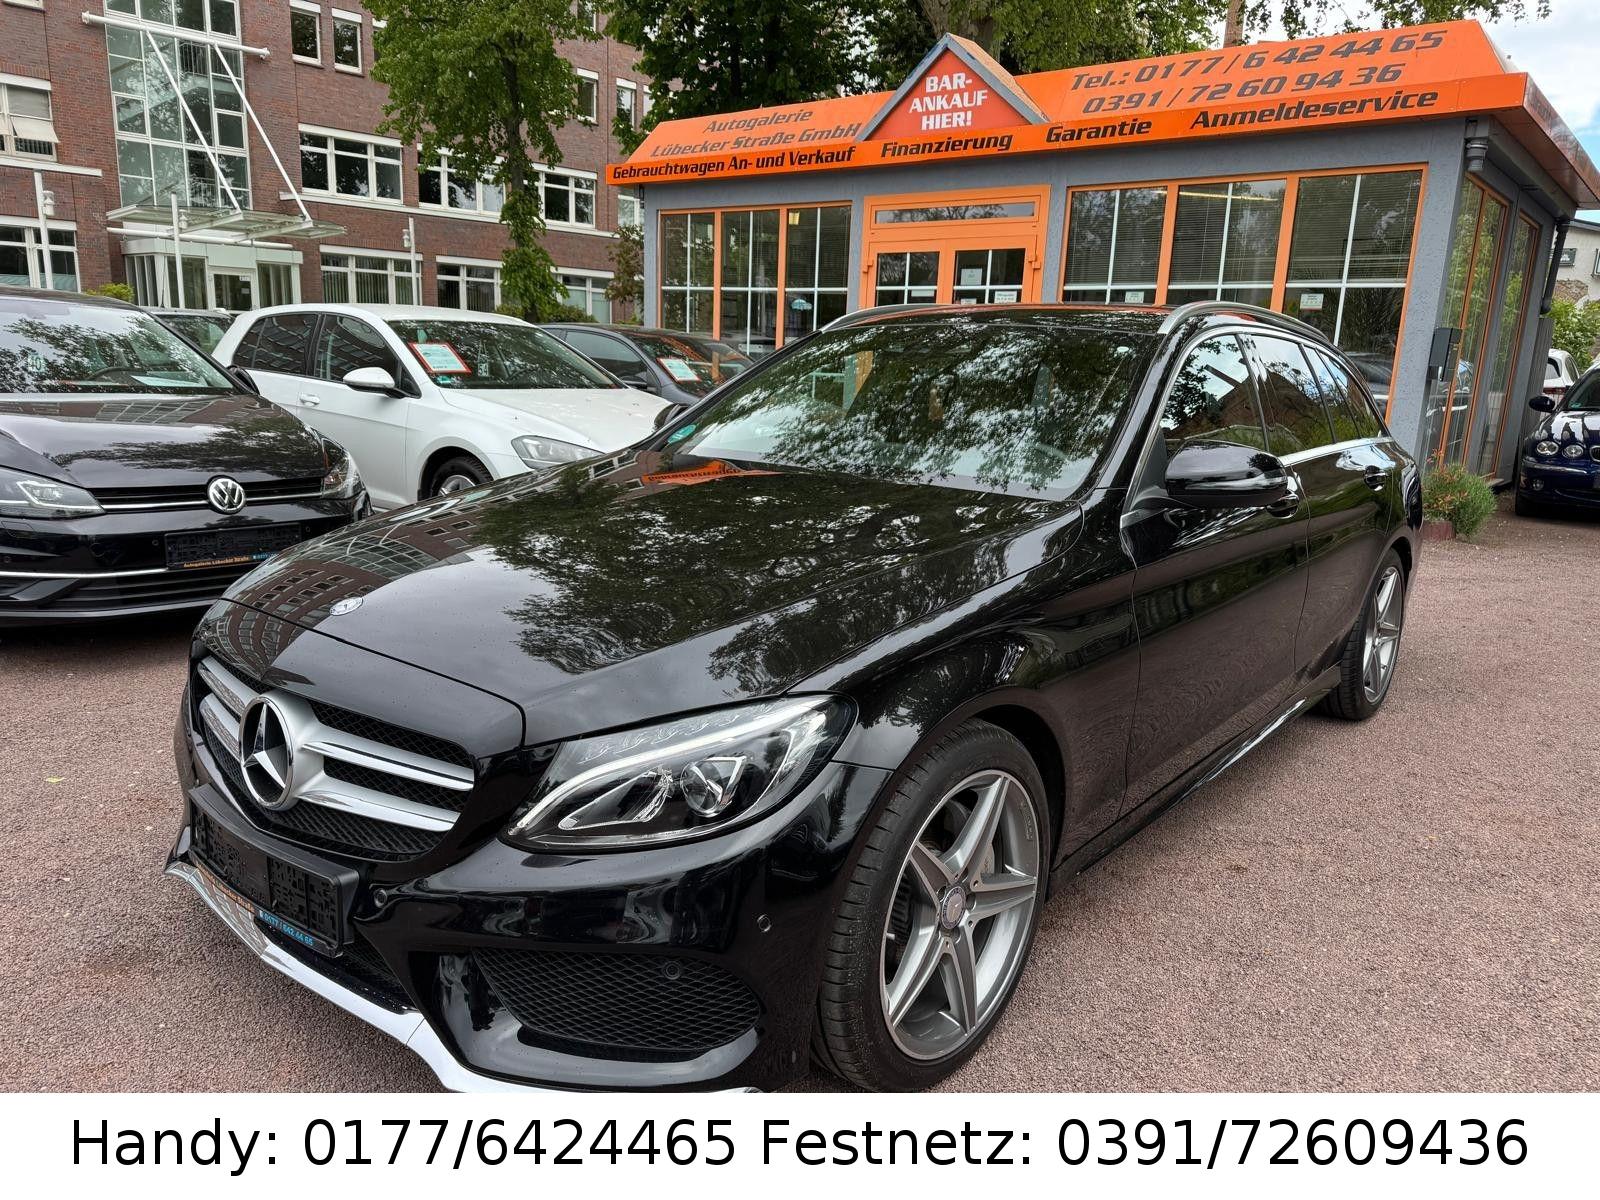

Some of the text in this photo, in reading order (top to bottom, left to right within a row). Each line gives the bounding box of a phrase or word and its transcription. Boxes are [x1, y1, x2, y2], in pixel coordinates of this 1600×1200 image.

[1071, 70, 1131, 91] Tel.:
[1134, 56, 1225, 84] 0177
[1272, 44, 1326, 66] 42
[1328, 37, 1385, 59] 44
[1390, 29, 1449, 53] 65
[925, 72, 973, 94] BAR-
[1082, 90, 1164, 114] 0391
[1187, 82, 1233, 103] 72
[1236, 75, 1288, 98] 60
[1290, 69, 1345, 93] 94
[1348, 62, 1407, 87] 36
[908, 89, 988, 114] ANKAUF
[1189, 89, 1440, 130] Anmeldeservice
[703, 108, 814, 134] Autogalerie
[921, 110, 973, 131] HIER!
[1045, 117, 1153, 144] Garantie
[649, 122, 862, 159] Lübecker Straße GmbH
[880, 133, 1014, 159] Finanzierung
[612, 145, 856, 180] Gebrauchtwagen An- und Verkauf
